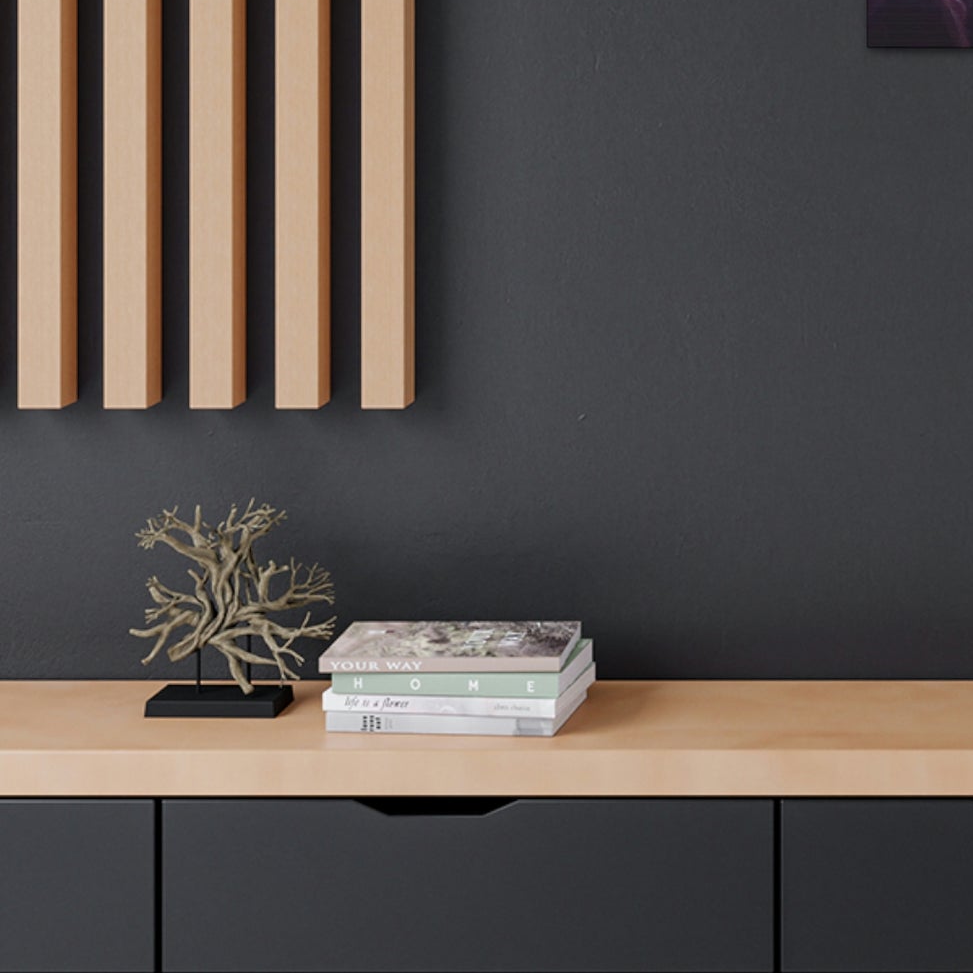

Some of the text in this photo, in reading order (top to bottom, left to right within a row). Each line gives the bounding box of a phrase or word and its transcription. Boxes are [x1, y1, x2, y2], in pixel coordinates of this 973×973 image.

[330, 661, 422, 671] YOUR WAY
[344, 695, 360, 710] life
[380, 697, 410, 711] flower
